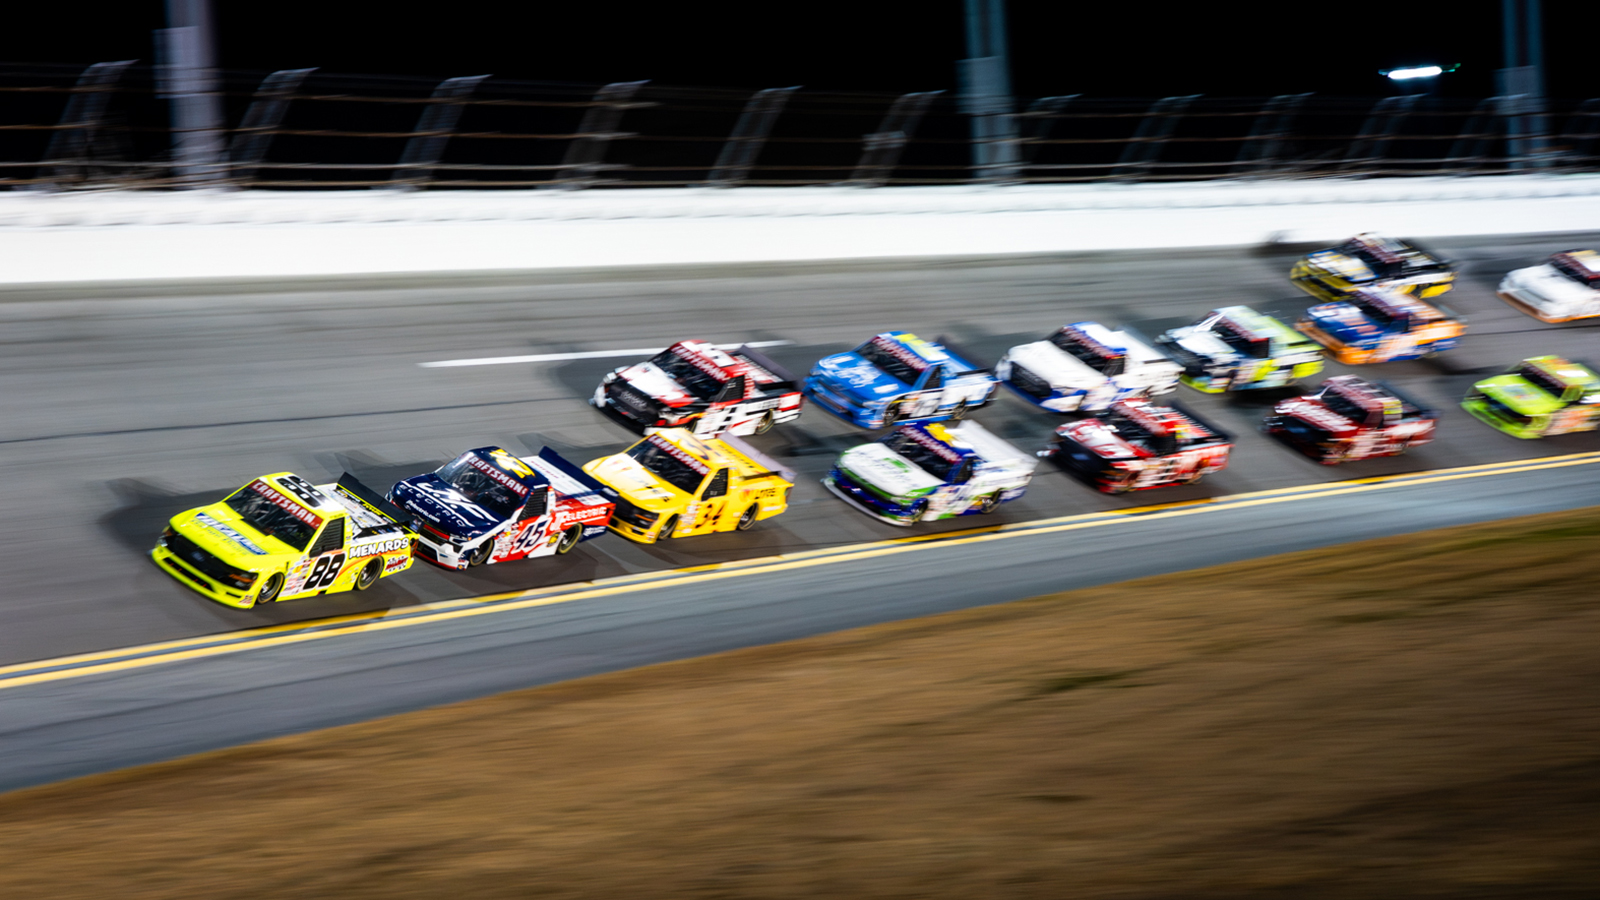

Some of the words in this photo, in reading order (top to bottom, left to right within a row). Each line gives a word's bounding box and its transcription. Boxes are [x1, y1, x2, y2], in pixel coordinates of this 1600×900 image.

[465, 455, 524, 493] RAFTSMAN
[251, 480, 315, 525] CRAFTSMAN
[565, 506, 607, 521] ELECTRIC
[348, 537, 410, 559] MENARDS
[511, 518, 551, 553] 45
[303, 553, 346, 590] 88
